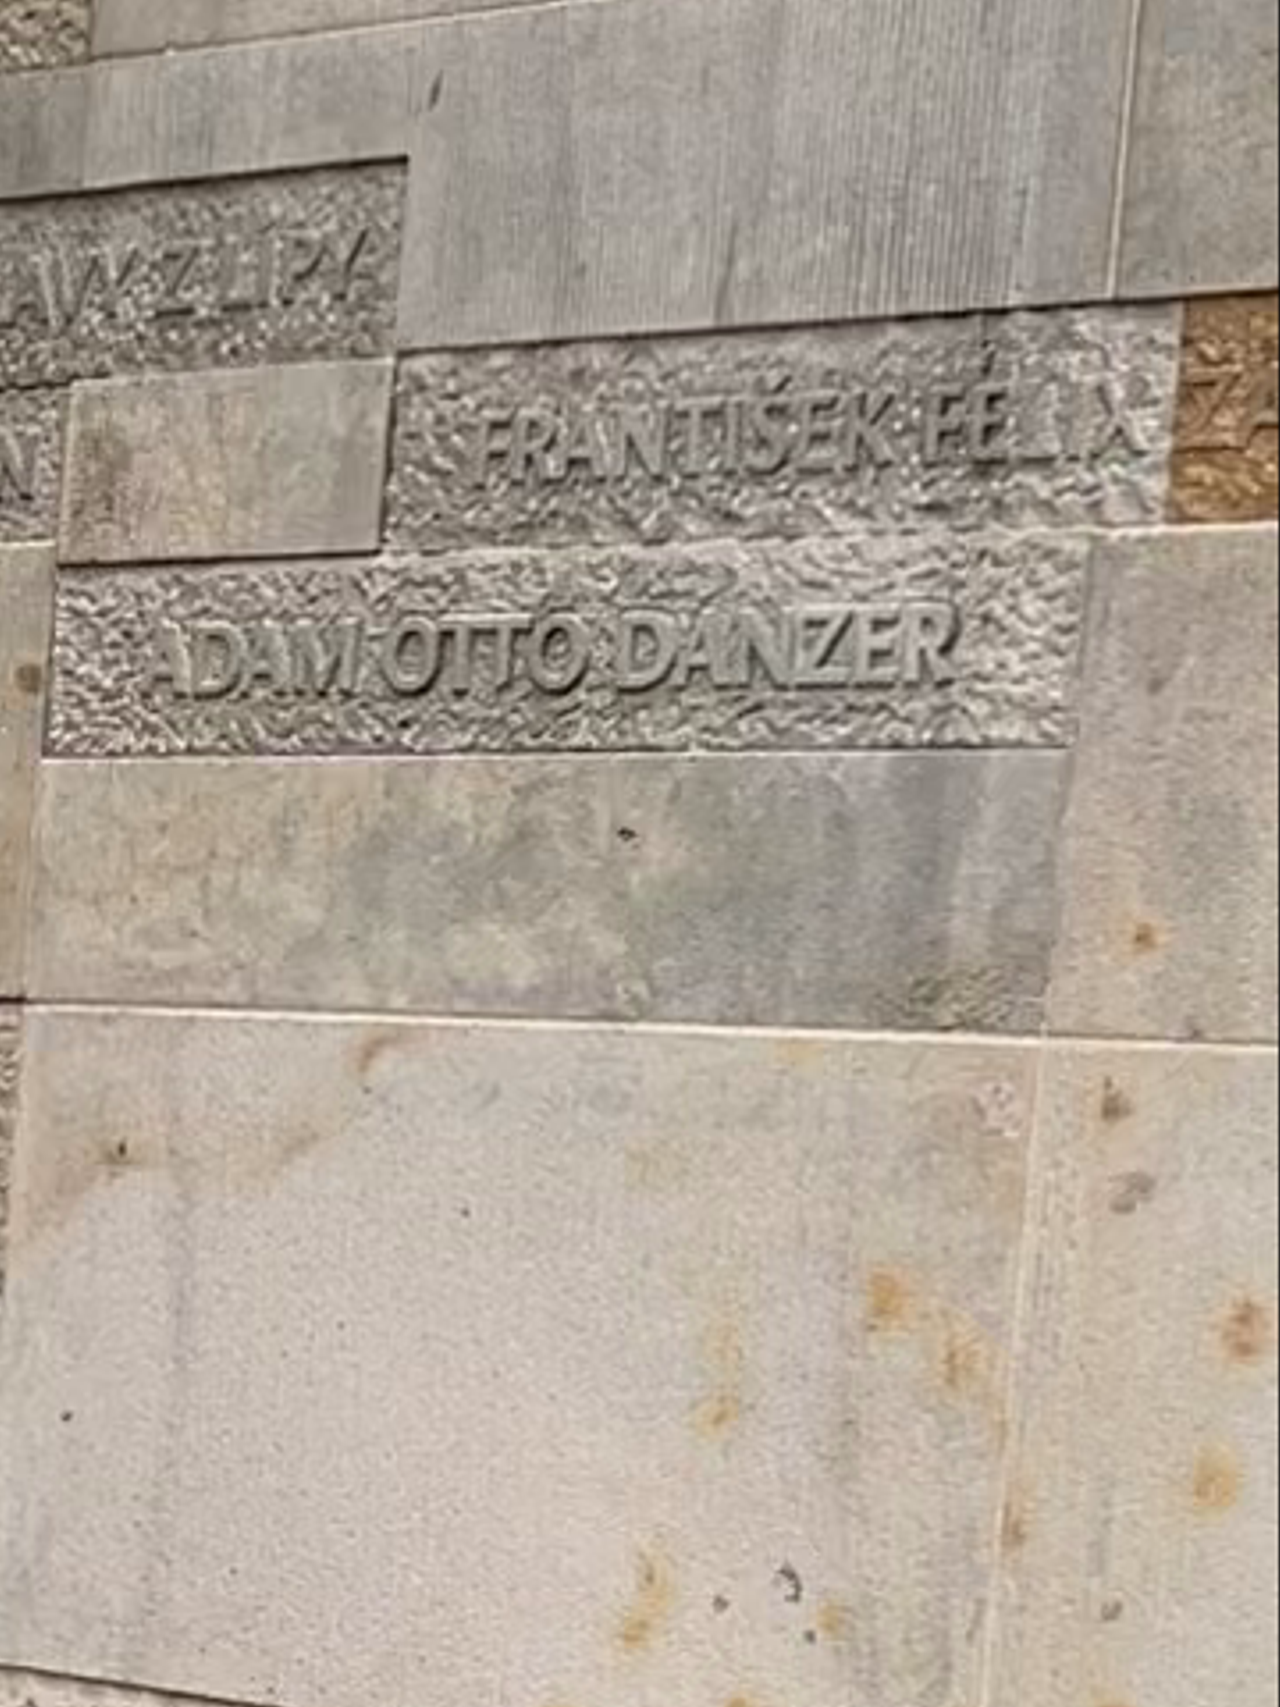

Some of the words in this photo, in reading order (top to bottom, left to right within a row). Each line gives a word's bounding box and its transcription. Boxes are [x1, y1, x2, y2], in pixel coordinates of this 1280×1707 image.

[472, 373, 908, 489] FRANTIŠEK
[142, 615, 366, 705] ADAM
[378, 607, 596, 699] OTTO
[614, 598, 960, 693] DANZER
